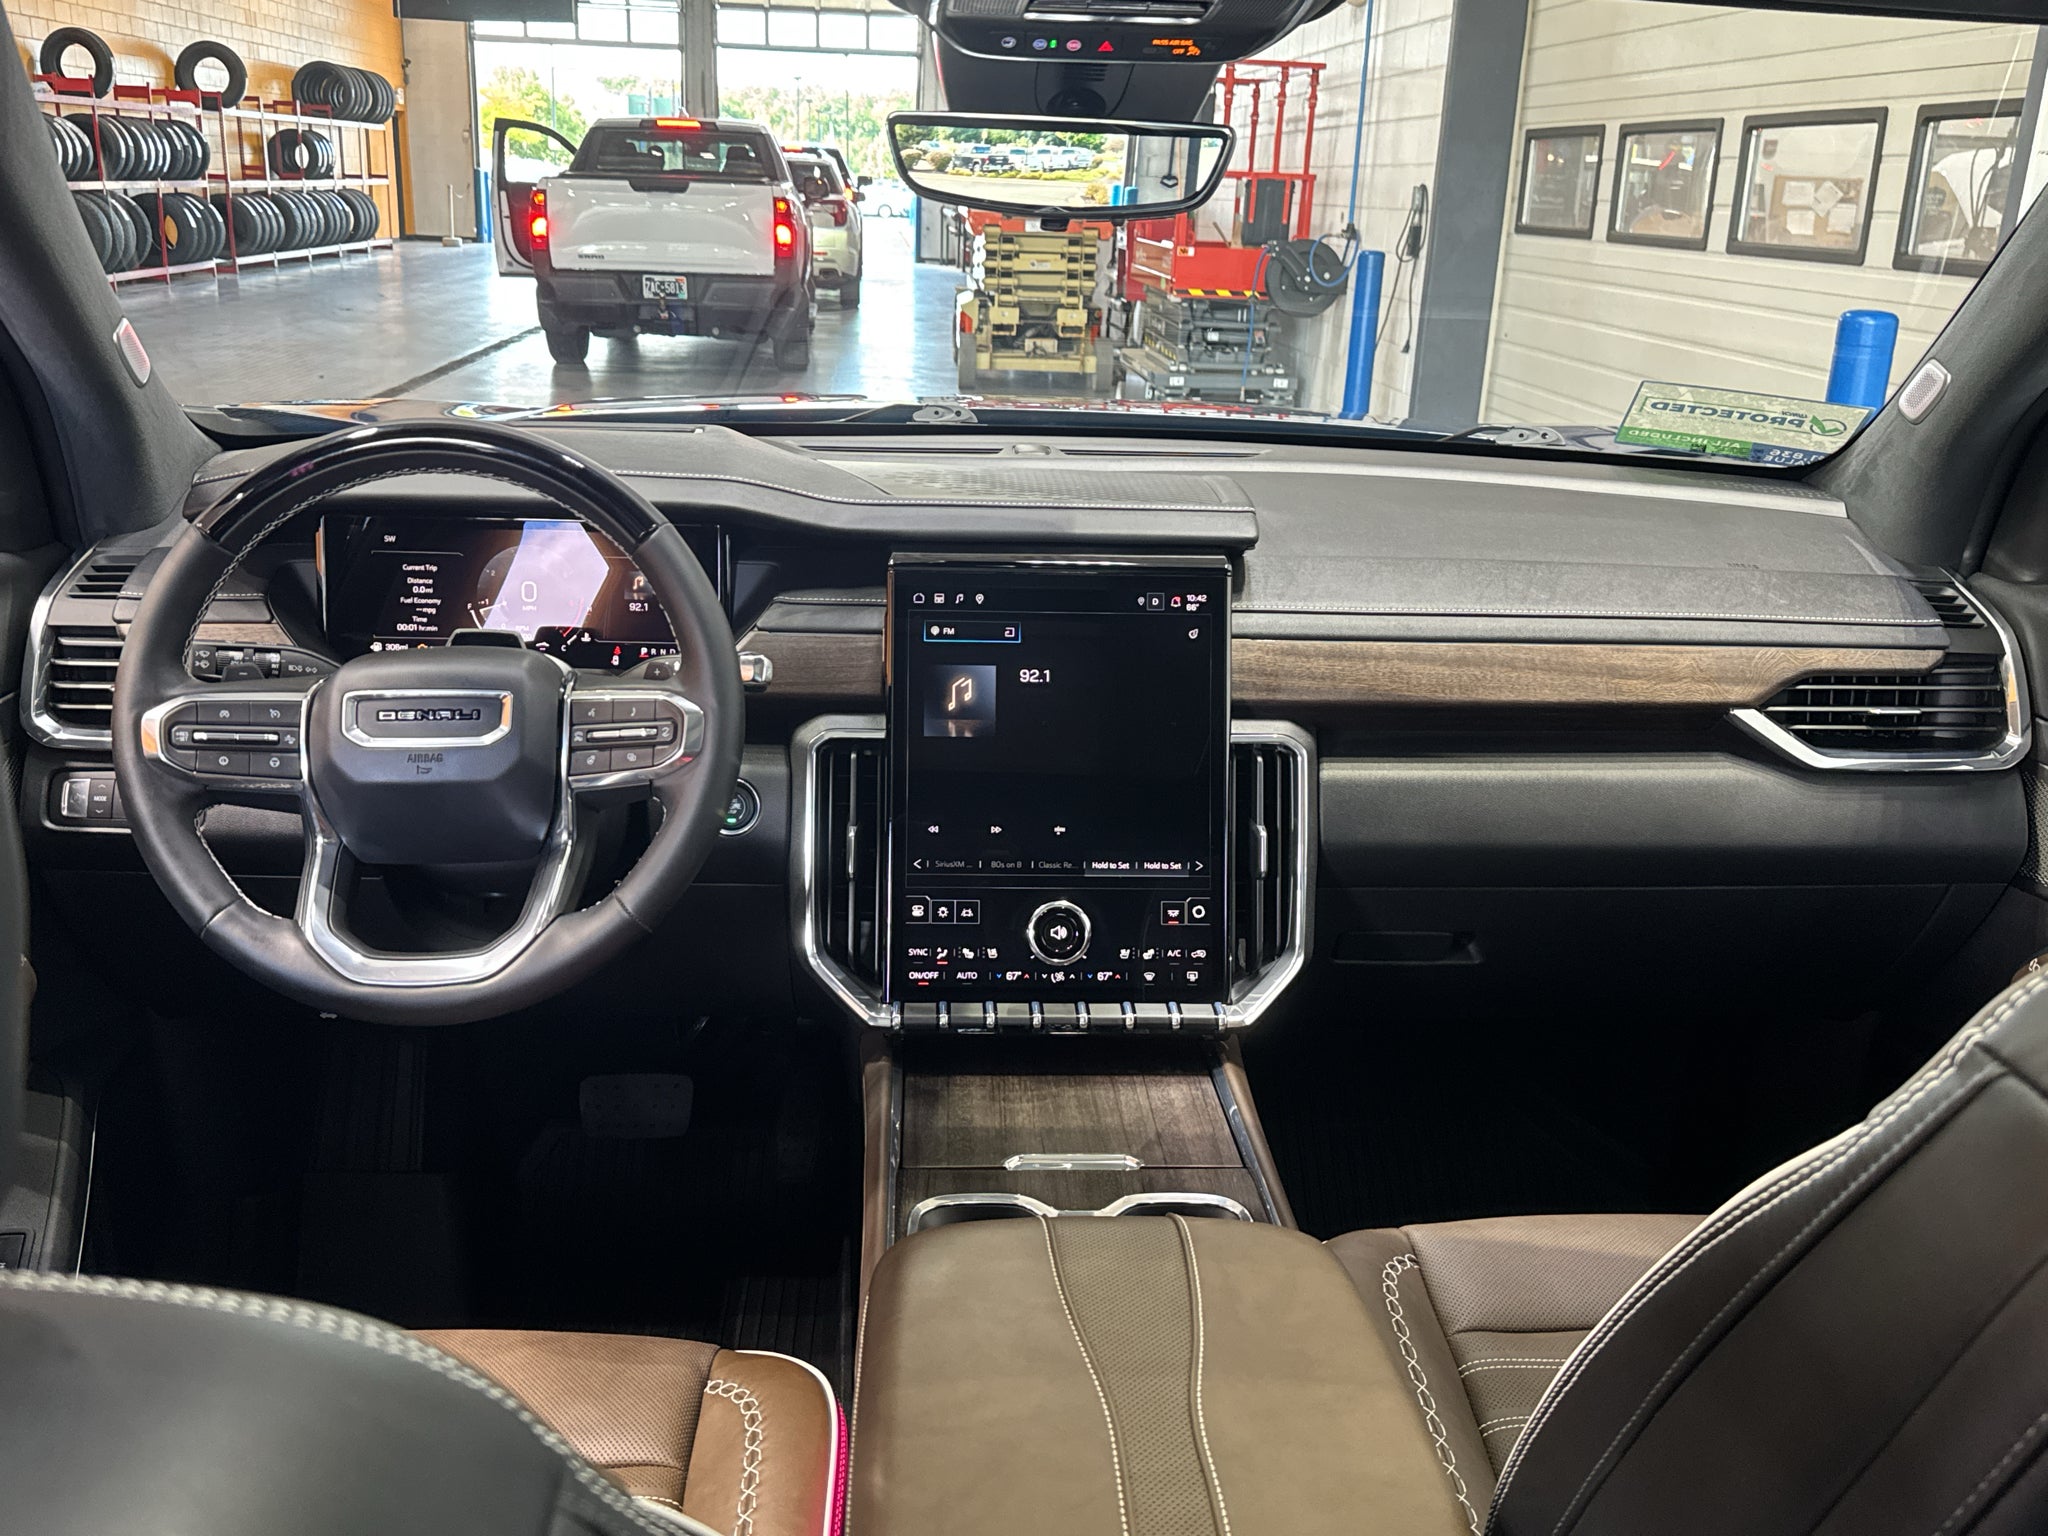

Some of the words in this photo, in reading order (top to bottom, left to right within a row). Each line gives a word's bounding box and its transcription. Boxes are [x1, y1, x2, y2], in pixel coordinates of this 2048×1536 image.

[383, 534, 397, 543] SW
[425, 564, 438, 572] Trip
[407, 577, 433, 585] Distance
[521, 580, 537, 603] 0
[400, 596, 413, 604] Fuel
[413, 597, 442, 606] Economy
[1186, 594, 1207, 602] 10:42
[628, 602, 649, 612] 92.1
[412, 615, 428, 623] Time
[396, 623, 418, 631] 00:01
[943, 627, 955, 635] FM
[640, 647, 648, 655] P
[1019, 669, 1050, 683] 92.1
[377, 708, 481, 722] DENALI
[406, 753, 444, 763] AIRBAG
[935, 860, 965, 868] SiriusXM
[1092, 861, 1108, 869] Hold
[1144, 861, 1160, 869] Hold
[1169, 862, 1182, 870] Set
[908, 948, 928, 956] SYNC
[1167, 949, 1181, 957] A/C
[908, 971, 939, 980] ON/OFF
[956, 971, 978, 979] AUTO
[1005, 971, 1022, 980] 67°
[1097, 971, 1113, 981] 67°
